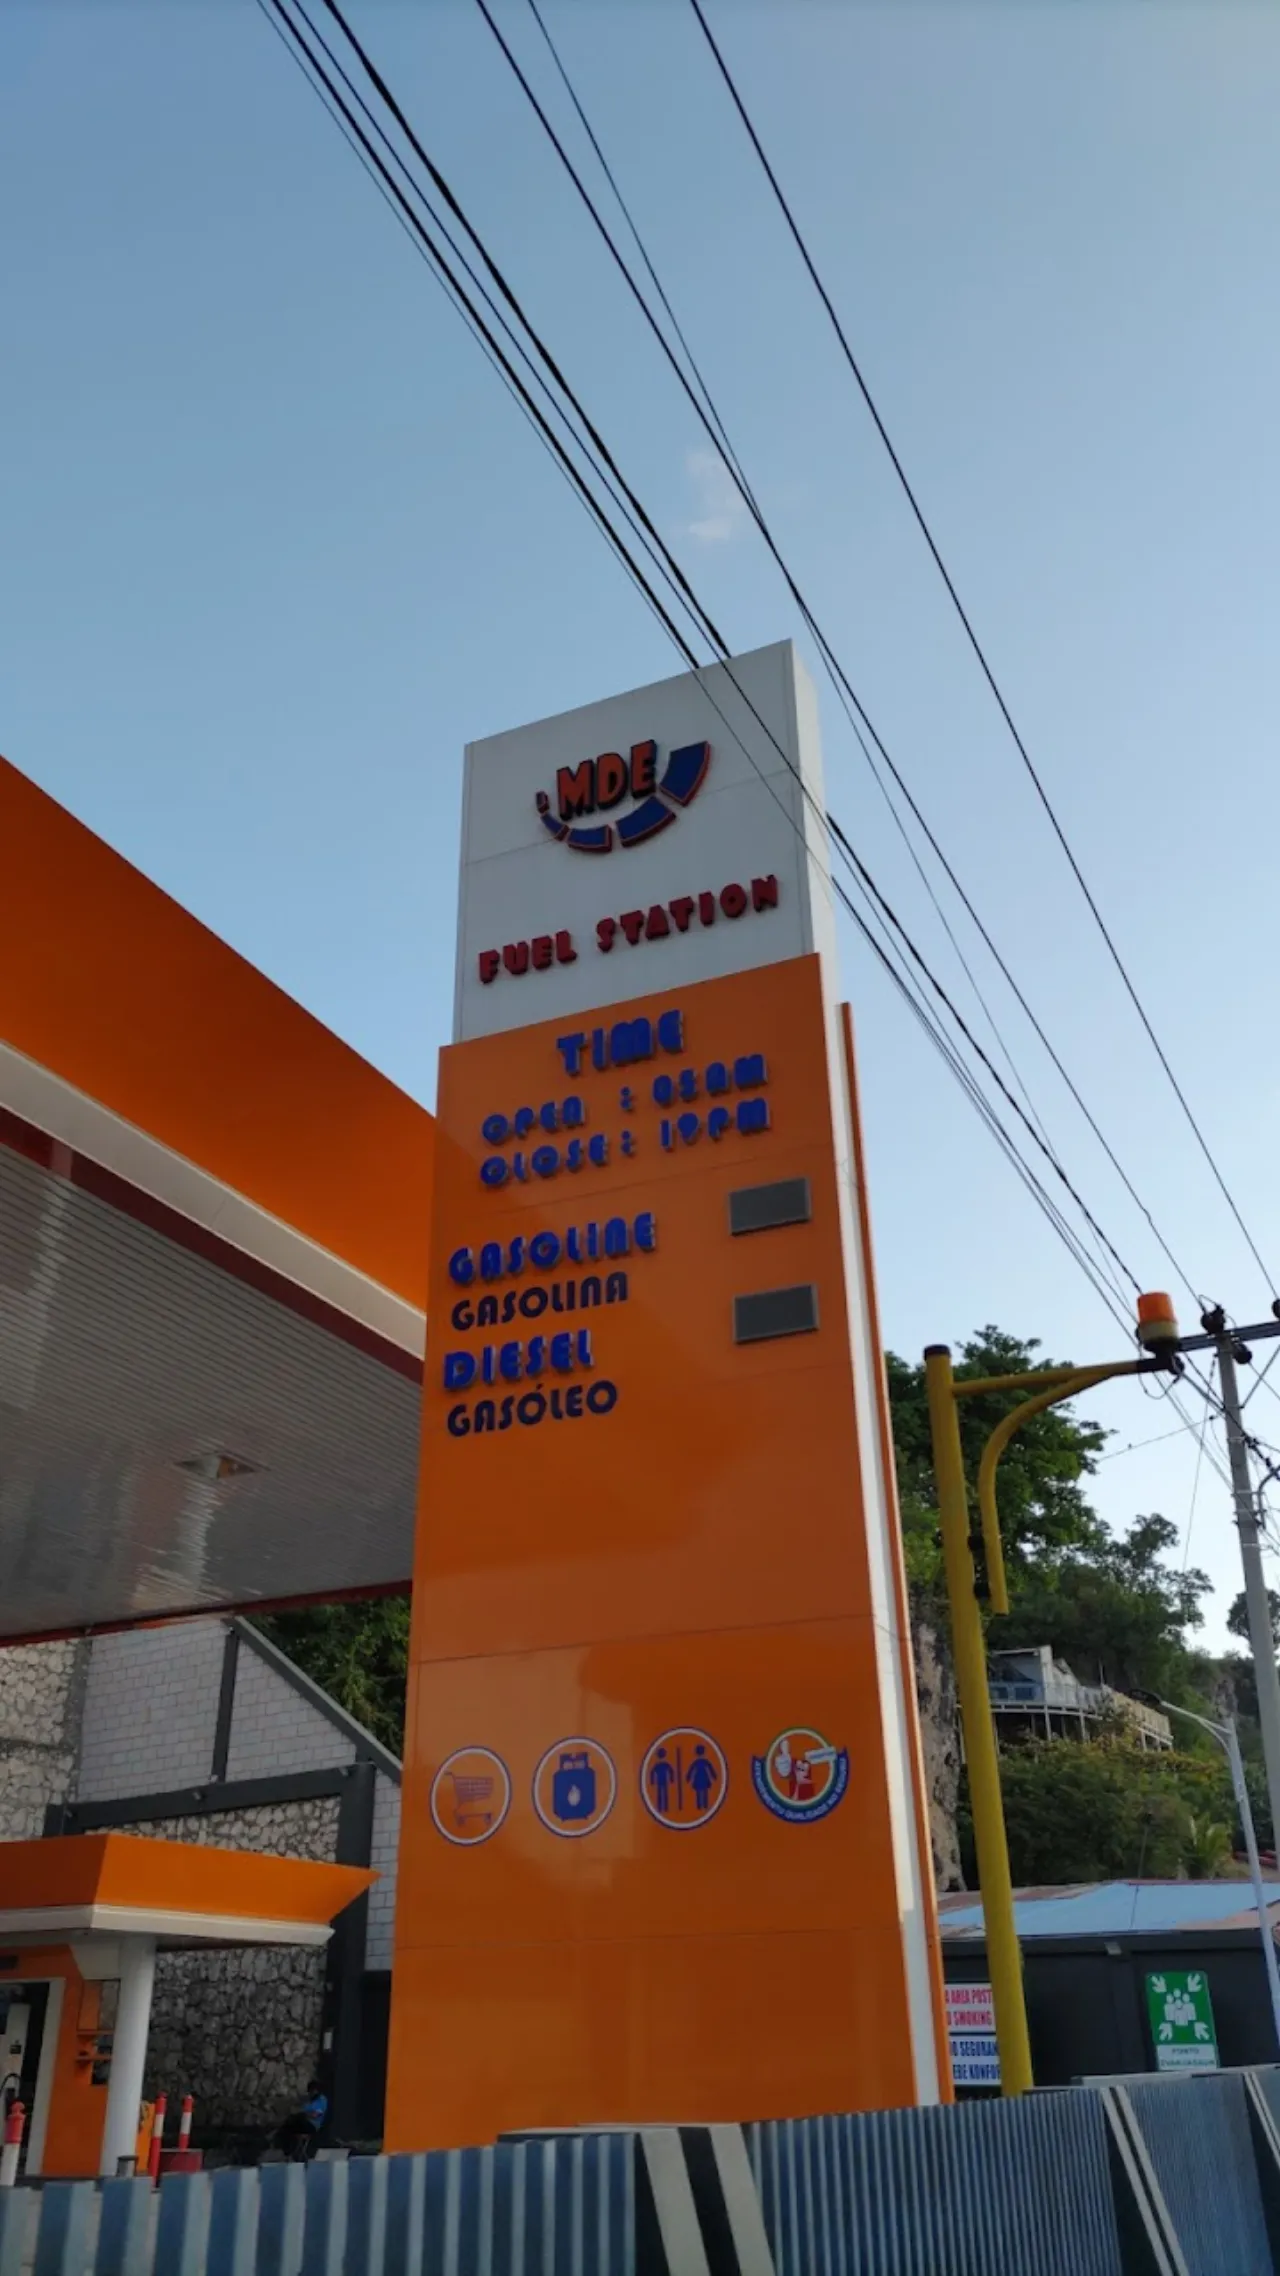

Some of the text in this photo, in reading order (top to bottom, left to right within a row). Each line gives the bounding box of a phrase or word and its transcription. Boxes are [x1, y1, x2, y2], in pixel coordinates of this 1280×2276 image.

[556, 740, 659, 821] MDE
[478, 874, 779, 984] FUEL STATION
[556, 1009, 684, 1077] TIME
[482, 1096, 585, 1145] OPEN
[448, 1211, 656, 1286] GASOLINE
[451, 1271, 629, 1332] GASOLINA
[443, 1329, 593, 1391] DIESEL
[447, 1379, 618, 1438] GASÓLEO
[953, 2010, 993, 2027] SMOKING
